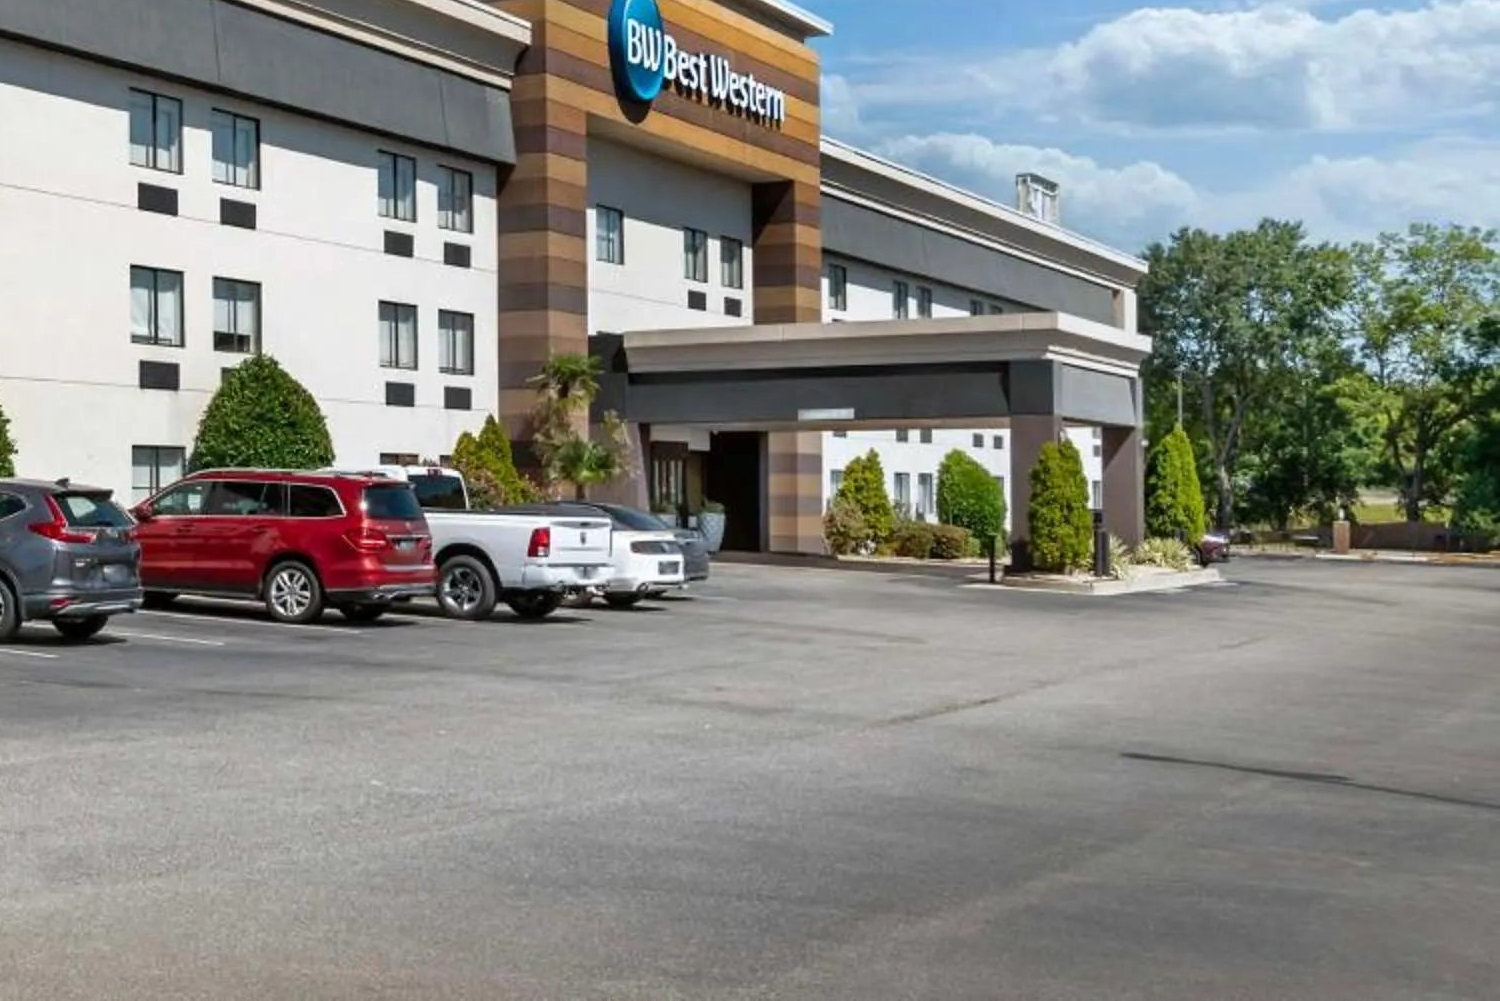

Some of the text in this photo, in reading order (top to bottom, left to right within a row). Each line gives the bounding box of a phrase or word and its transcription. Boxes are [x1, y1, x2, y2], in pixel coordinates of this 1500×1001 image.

[626, 18, 662, 72] BW
[663, 34, 786, 122] Best Western
